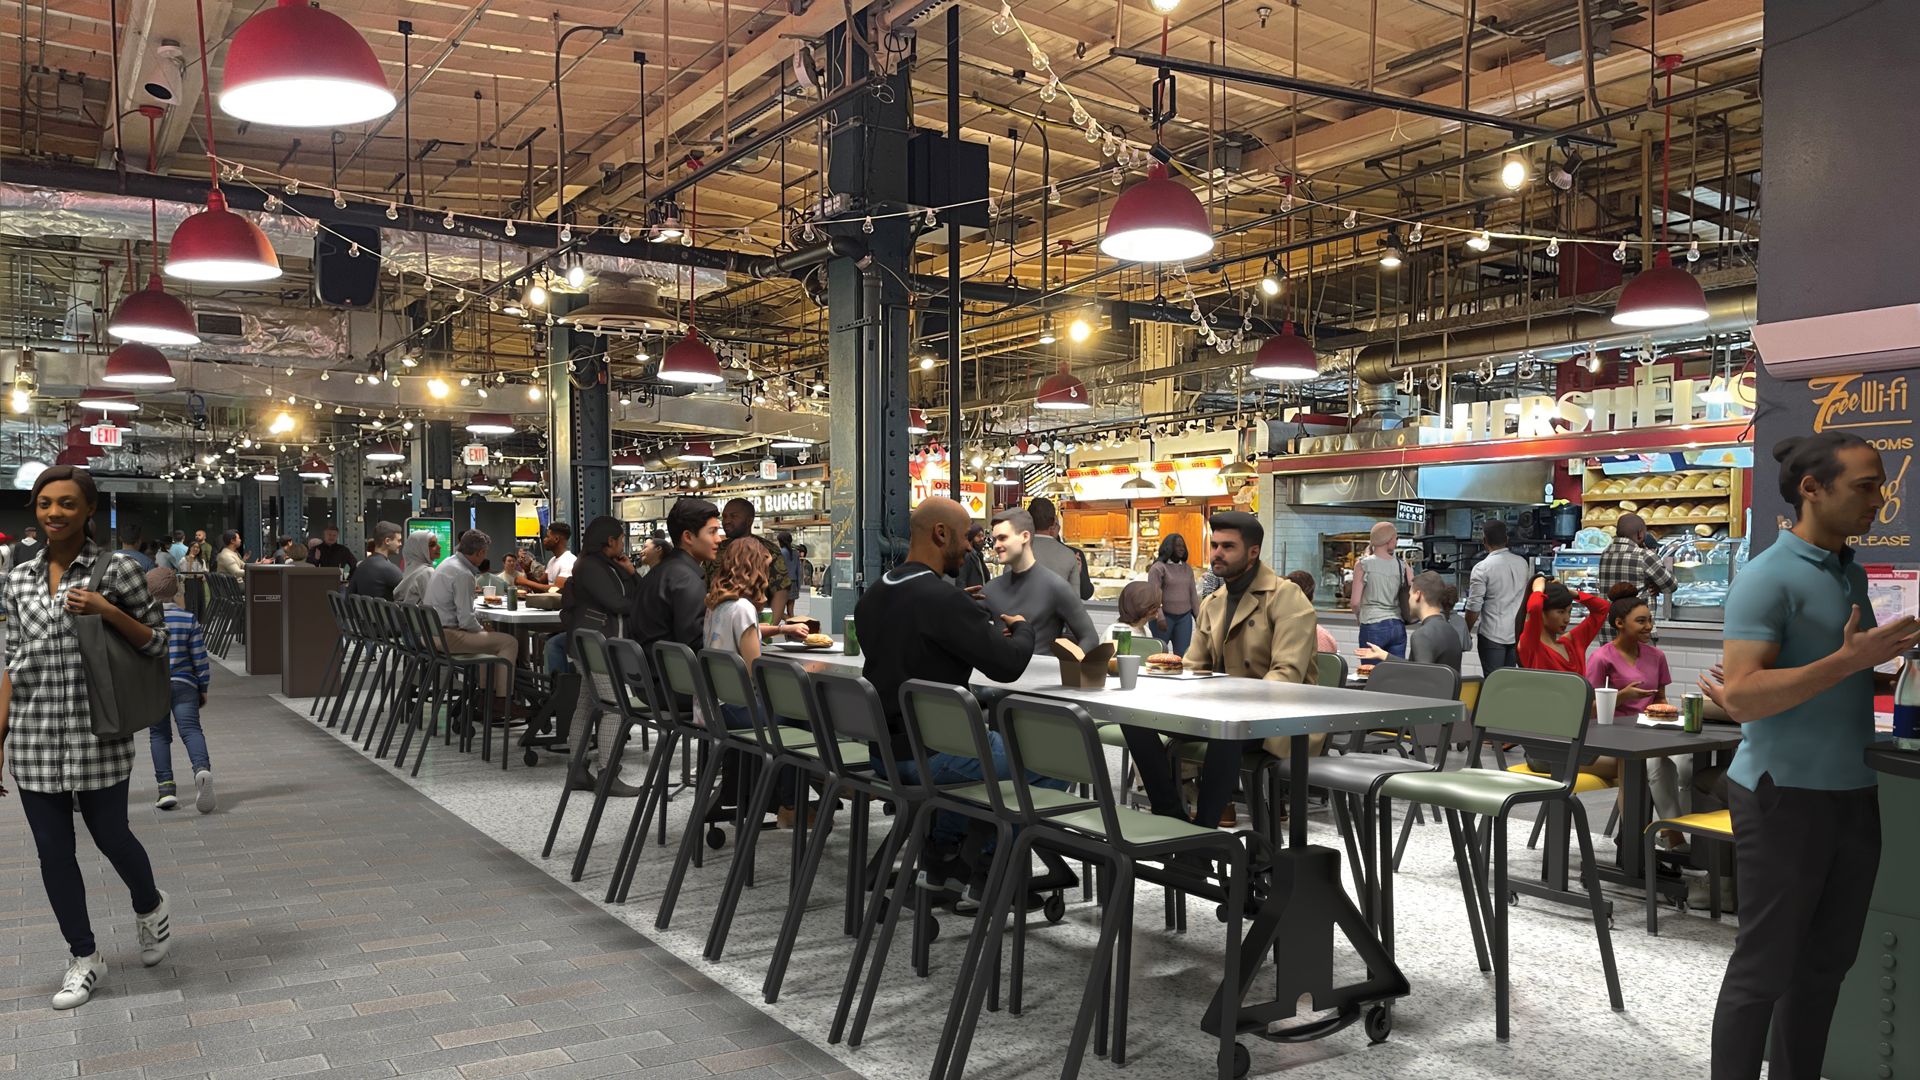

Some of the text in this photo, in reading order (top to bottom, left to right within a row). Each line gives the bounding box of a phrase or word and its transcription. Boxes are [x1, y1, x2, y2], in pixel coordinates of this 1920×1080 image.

[1808, 373, 1863, 433] Free
[97, 427, 117, 444] EXIT
[469, 447, 485, 463] EXIT
[935, 481, 972, 491] ORER
[765, 491, 814, 512] BURGER
